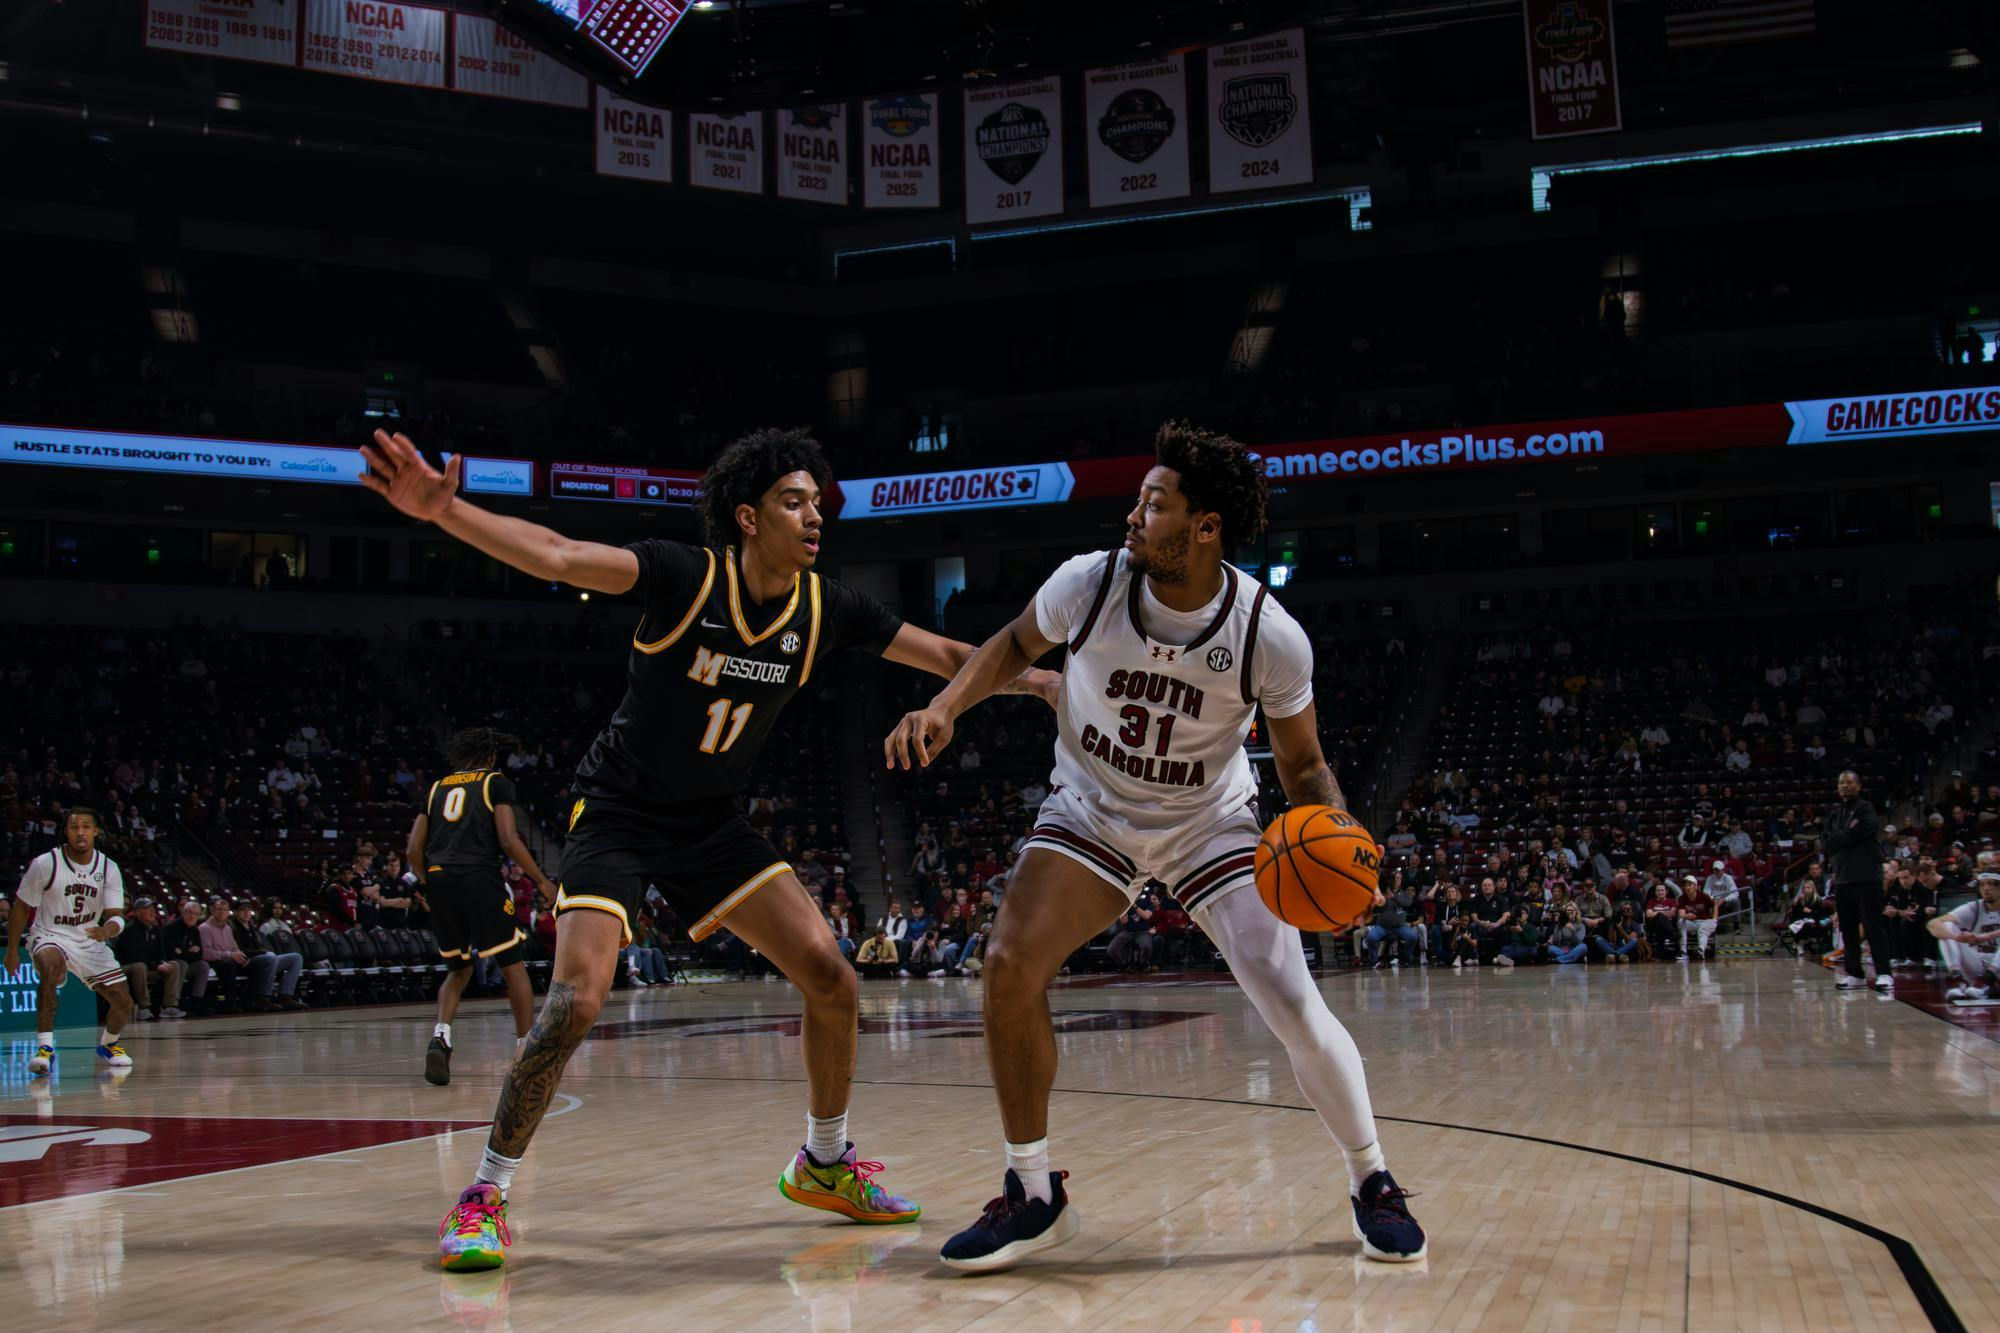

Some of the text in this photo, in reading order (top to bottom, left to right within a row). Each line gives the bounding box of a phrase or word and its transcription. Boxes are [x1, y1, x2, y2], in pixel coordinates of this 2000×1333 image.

[151, 10, 293, 42] 1986 1988 1989 1991
[346, 0, 404, 31] NCAA
[150, 26, 219, 47] 2003 2013
[1538, 60, 1607, 93] NCAA
[1228, 82, 1286, 102] NATIONAL
[1552, 89, 1598, 104] FINAL FOUR
[1223, 98, 1292, 121] CHAMPIONS
[1558, 104, 1592, 122] 2017
[603, 107, 664, 139] NCAA
[979, 121, 1046, 142] NATIONAL
[1105, 121, 1169, 139] CHAMPIONS
[697, 121, 755, 152] NCAA
[784, 132, 840, 164] NCAA
[871, 144, 931, 167] NCAA
[983, 138, 1044, 158] CHAMPIONS
[618, 151, 651, 168] 2015
[1241, 159, 1280, 178] 2024
[712, 163, 741, 180] 2021
[798, 175, 828, 192] 2023
[886, 183, 918, 197] 2025
[1120, 173, 1157, 192] 2022
[996, 191, 1032, 209] 2017
[1826, 391, 2000, 432] GAMECOCKS
[14, 441, 272, 467] HUSTLE STATS BROUGHT TO YOU BY:
[281, 460, 338, 473] Colonial Life
[552, 463, 649, 477] OUT OF TOWN SCORES
[561, 481, 610, 493] HOUSTON
[668, 487, 693, 497] 10:30
[782, 632, 800, 653] SEC
[687, 645, 791, 687] MISSOURI
[1208, 647, 1233, 671] SEC
[1105, 669, 1204, 720] SOUTH
[699, 698, 754, 755] 11
[1118, 703, 1177, 757] 31
[1080, 724, 1205, 787] CAROLINA
[442, 786, 467, 823] 0
[64, 883, 98, 898] SOUTH
[73, 896, 85, 914] 5
